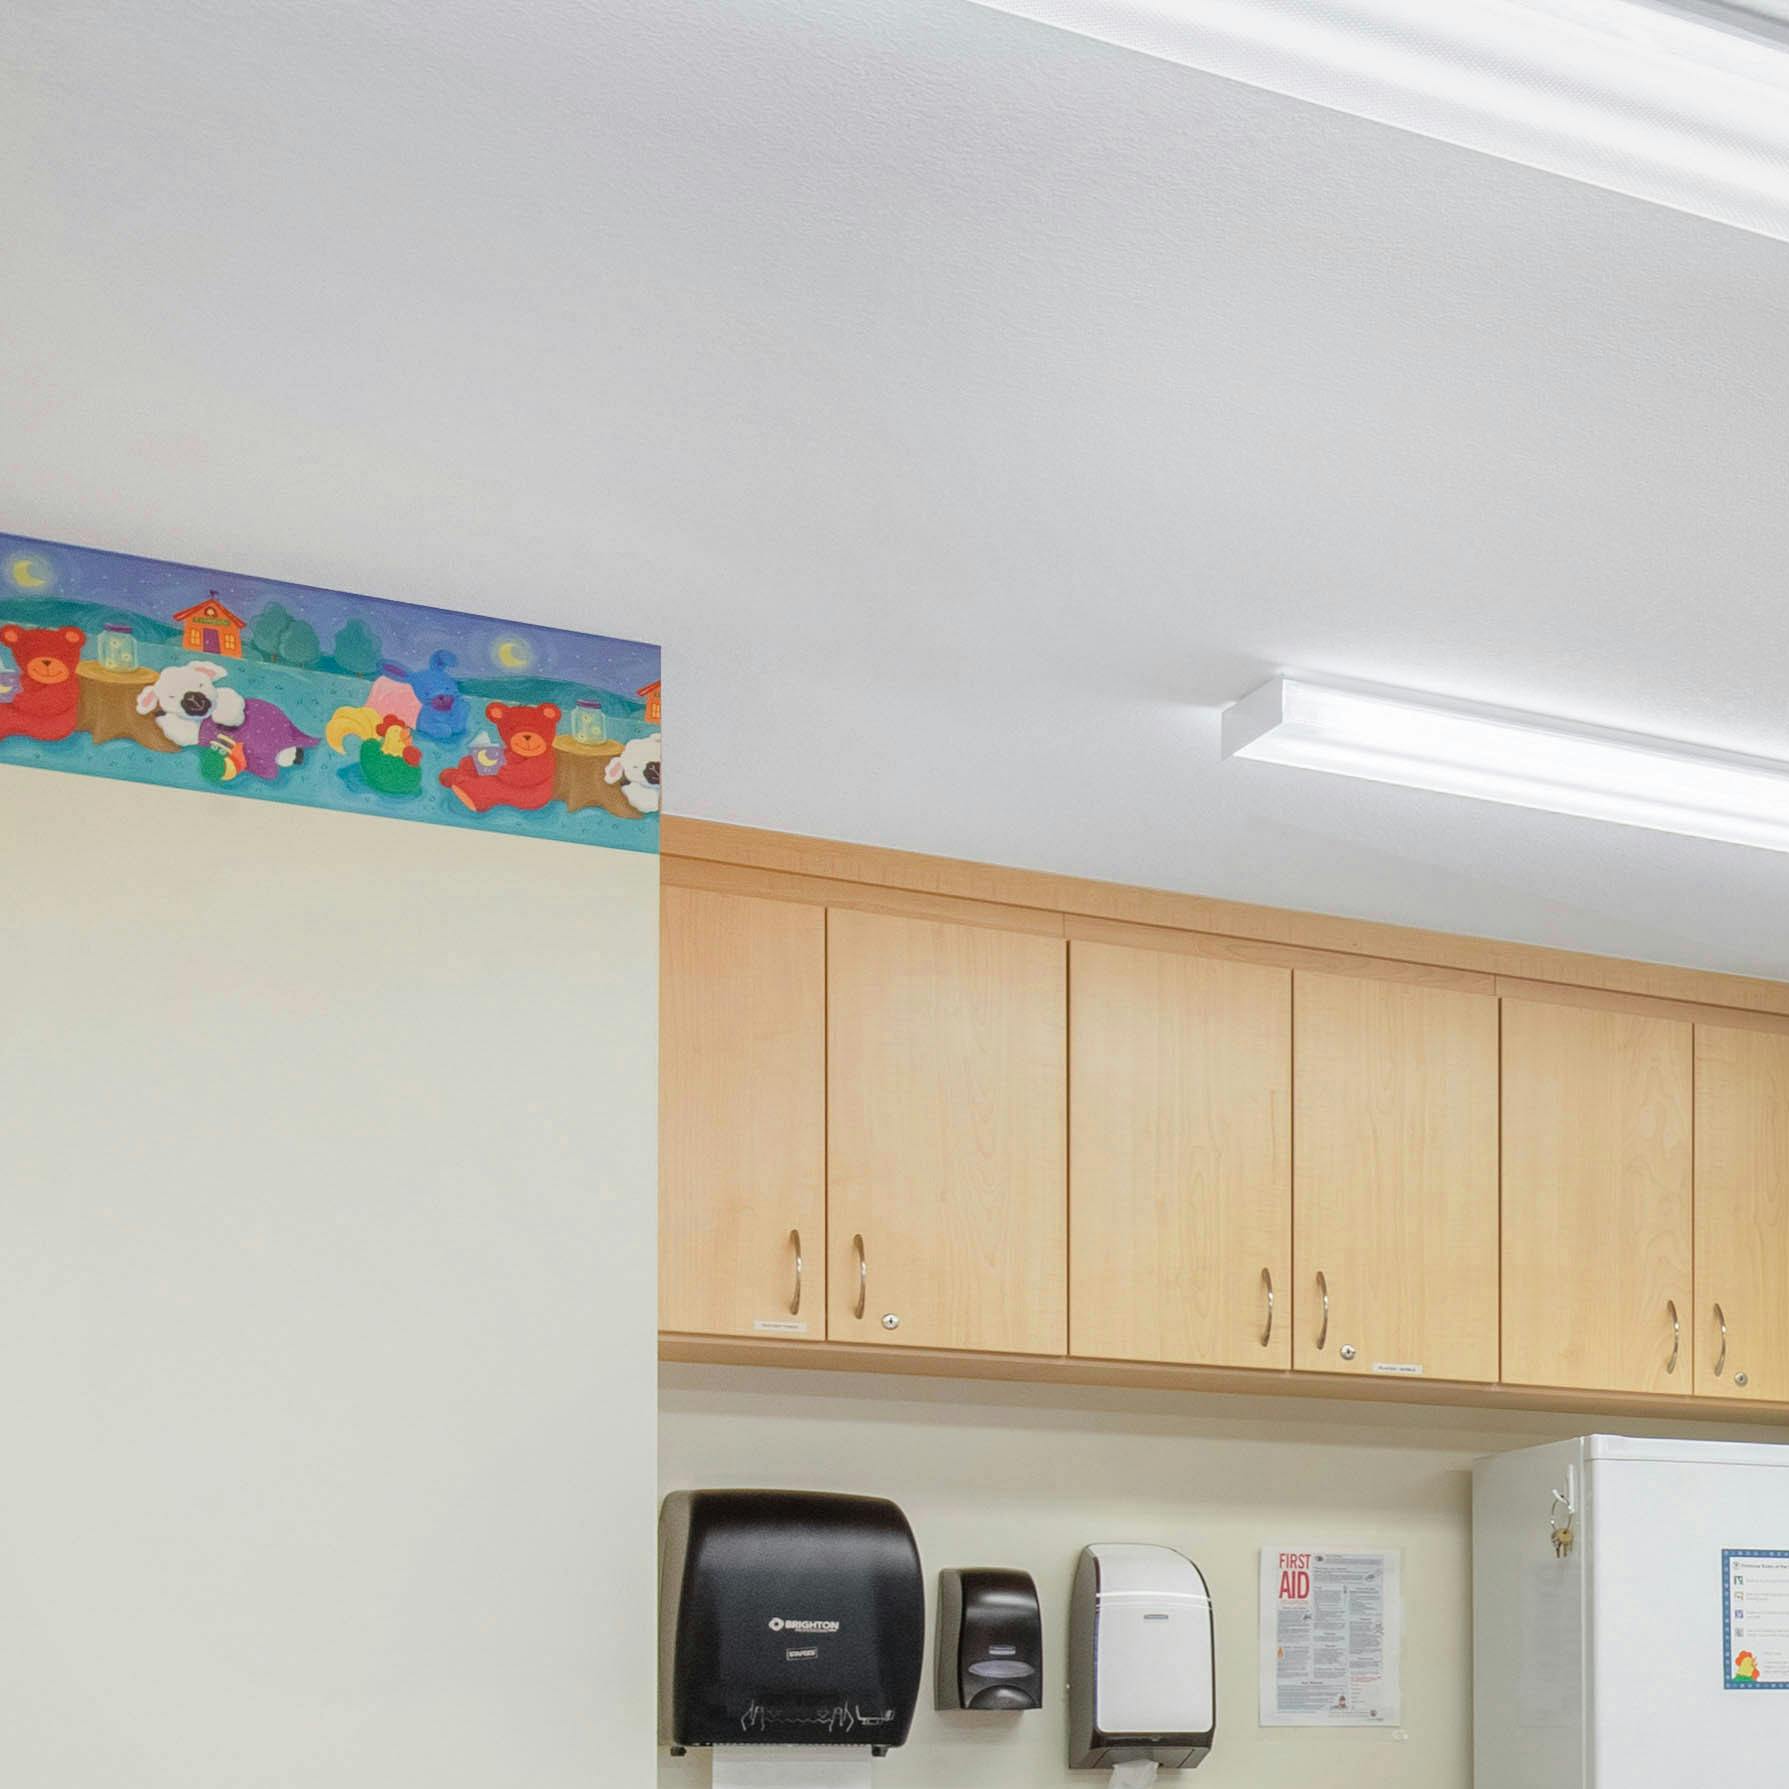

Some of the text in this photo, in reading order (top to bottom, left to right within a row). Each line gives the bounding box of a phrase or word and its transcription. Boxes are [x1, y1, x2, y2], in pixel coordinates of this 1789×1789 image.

[1279, 1553, 1311, 1568] FIRST
[1279, 1571, 1310, 1599] AID
[785, 1620, 839, 1629] BRIGHTON
